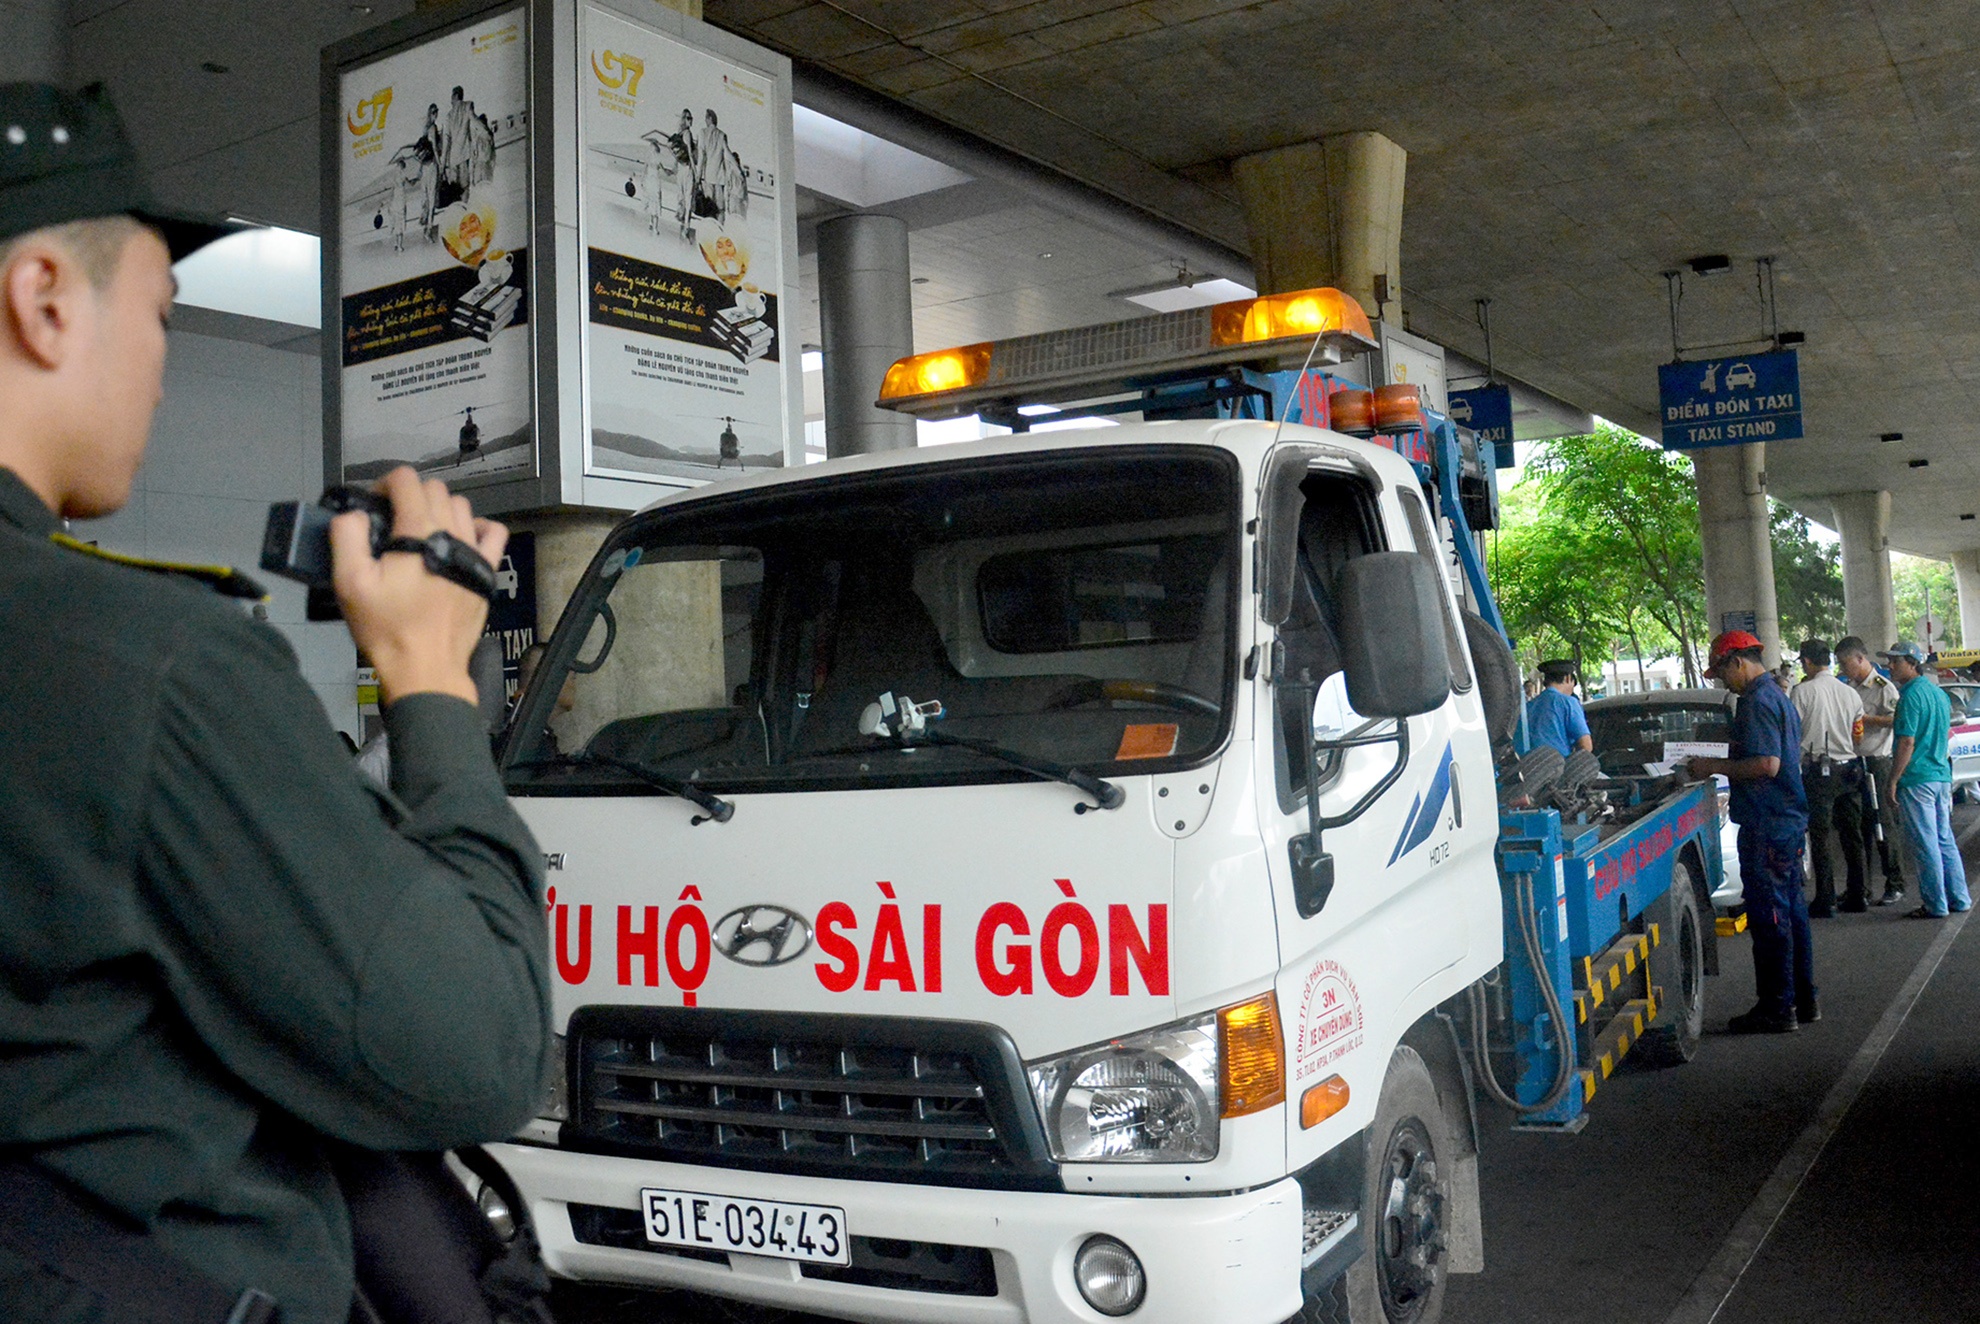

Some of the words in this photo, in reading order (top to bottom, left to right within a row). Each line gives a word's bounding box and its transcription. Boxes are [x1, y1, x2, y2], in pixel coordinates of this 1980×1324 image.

[1667, 397, 1710, 421] ĐIỂM
[1715, 396, 1750, 415] ĐÓN
[1755, 393, 1793, 411] TAXI
[1687, 426, 1722, 443] TAXI
[1726, 420, 1776, 439] STAND
[503, 627, 533, 660] TAXI
[617, 884, 711, 1007] HỘ
[814, 880, 942, 993] SÀI
[975, 878, 1170, 998] GÒN
[1322, 987, 1336, 1008] 3N
